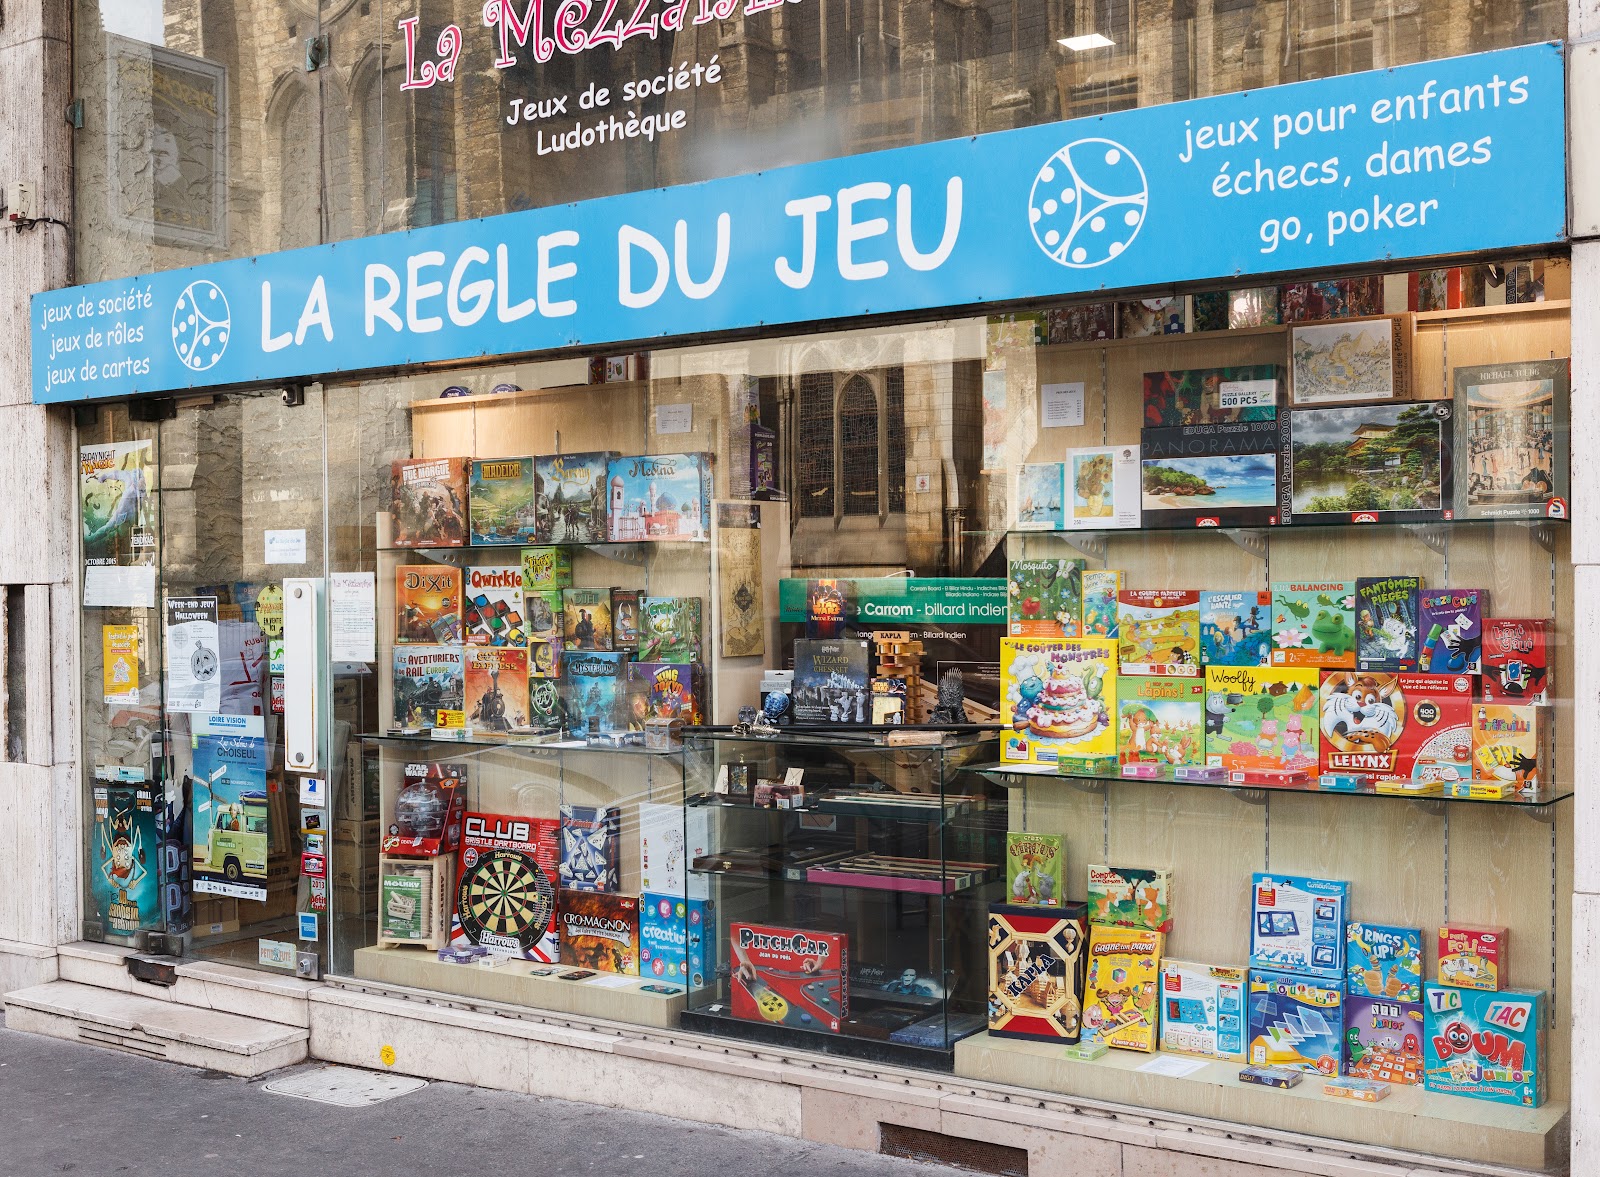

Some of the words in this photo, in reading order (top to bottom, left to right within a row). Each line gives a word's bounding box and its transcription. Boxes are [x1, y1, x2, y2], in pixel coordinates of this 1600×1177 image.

[399, 15, 463, 92] La
[506, 93, 568, 126] Jeux
[579, 82, 611, 110] de
[623, 54, 723, 99] société
[1178, 116, 1260, 164] jeux
[1273, 103, 1357, 150] pour
[1371, 74, 1529, 124] enfants
[536, 109, 687, 156] Ludothèque
[1212, 156, 1352, 198] échecs,
[1365, 135, 1492, 178] dames
[1259, 216, 1314, 254] go,
[1327, 194, 1439, 247] poker
[261, 274, 334, 353] LA
[364, 230, 580, 337] REGLE
[618, 211, 731, 309] DU
[774, 175, 963, 289] JEU
[41, 304, 73, 331] jeux
[76, 296, 95, 319] de
[98, 284, 153, 316] société
[49, 334, 81, 361] jeux
[85, 326, 103, 349] de
[107, 321, 144, 347] rôles
[44, 366, 76, 393] jeux
[80, 359, 98, 382] de
[102, 356, 150, 379] cartes
[1221, 397, 1238, 406] 500
[1240, 396, 1258, 405] PCS
[1182, 425, 1215, 436] EDUCA
[1217, 423, 1249, 434] Puzzle
[1250, 421, 1277, 432] 1000
[1281, 410, 1291, 440] 2000
[1142, 436, 1276, 456] PANORAMA
[628, 458, 676, 478] Medina
[1281, 443, 1291, 482] Puzzle
[417, 463, 450, 479] MORGUE
[482, 463, 520, 479] MADEIRA
[1281, 484, 1292, 525] EDUCA
[1011, 559, 1054, 576] Mosquito
[471, 569, 523, 589] Qwirkle
[1290, 583, 1344, 592] BALANCING
[1359, 578, 1418, 599] FANTÔMES
[167, 599, 198, 610] WEEK-END
[199, 600, 215, 609] JEUX
[1371, 590, 1410, 605] PIÉGÉS
[174, 611, 209, 621] HALLOWEEN
[812, 607, 841, 615] WARS
[864, 602, 914, 616] Carrom
[924, 602, 966, 616] billard
[880, 632, 902, 640] KAPLA
[923, 631, 944, 639] Billard
[944, 631, 967, 639] Indien
[1014, 642, 1024, 651] LE
[1026, 642, 1065, 654] GOÛTER
[1065, 642, 1082, 652] DES
[1050, 648, 1110, 664] MONSTRES
[407, 653, 460, 665] AVENTURIERS
[471, 660, 518, 671] EXPRESS
[574, 660, 614, 674] MYSTERIUM
[812, 654, 849, 665] WIZARD
[406, 666, 425, 677] RAIL
[425, 665, 450, 675] EUROPE
[655, 669, 679, 683] KING
[1210, 668, 1257, 693] Woolfy
[1136, 682, 1178, 700] Lapins
[208, 715, 225, 723] LOIRE
[216, 747, 257, 759] CHOISEUL
[1334, 754, 1350, 767] LE
[1351, 753, 1391, 769] LYNX
[404, 769, 429, 777] WARS
[405, 763, 428, 771] STAR
[465, 817, 531, 842] CLUB
[464, 836, 493, 847] BRISTLE
[492, 838, 537, 851] DARTBOARD
[1090, 869, 1117, 880] Compte
[479, 929, 520, 949] Harrows
[1364, 928, 1403, 948] RINGS
[1094, 942, 1120, 954] Gagne
[1372, 943, 1395, 960] UP!
[1007, 953, 1057, 998] KAPLA
[1431, 990, 1459, 1011] TIC
[1370, 1016, 1405, 1031] Junior
[1489, 1004, 1528, 1029] TAC
[1469, 1064, 1535, 1084] Junior
[1523, 1086, 1534, 1096] 6+
